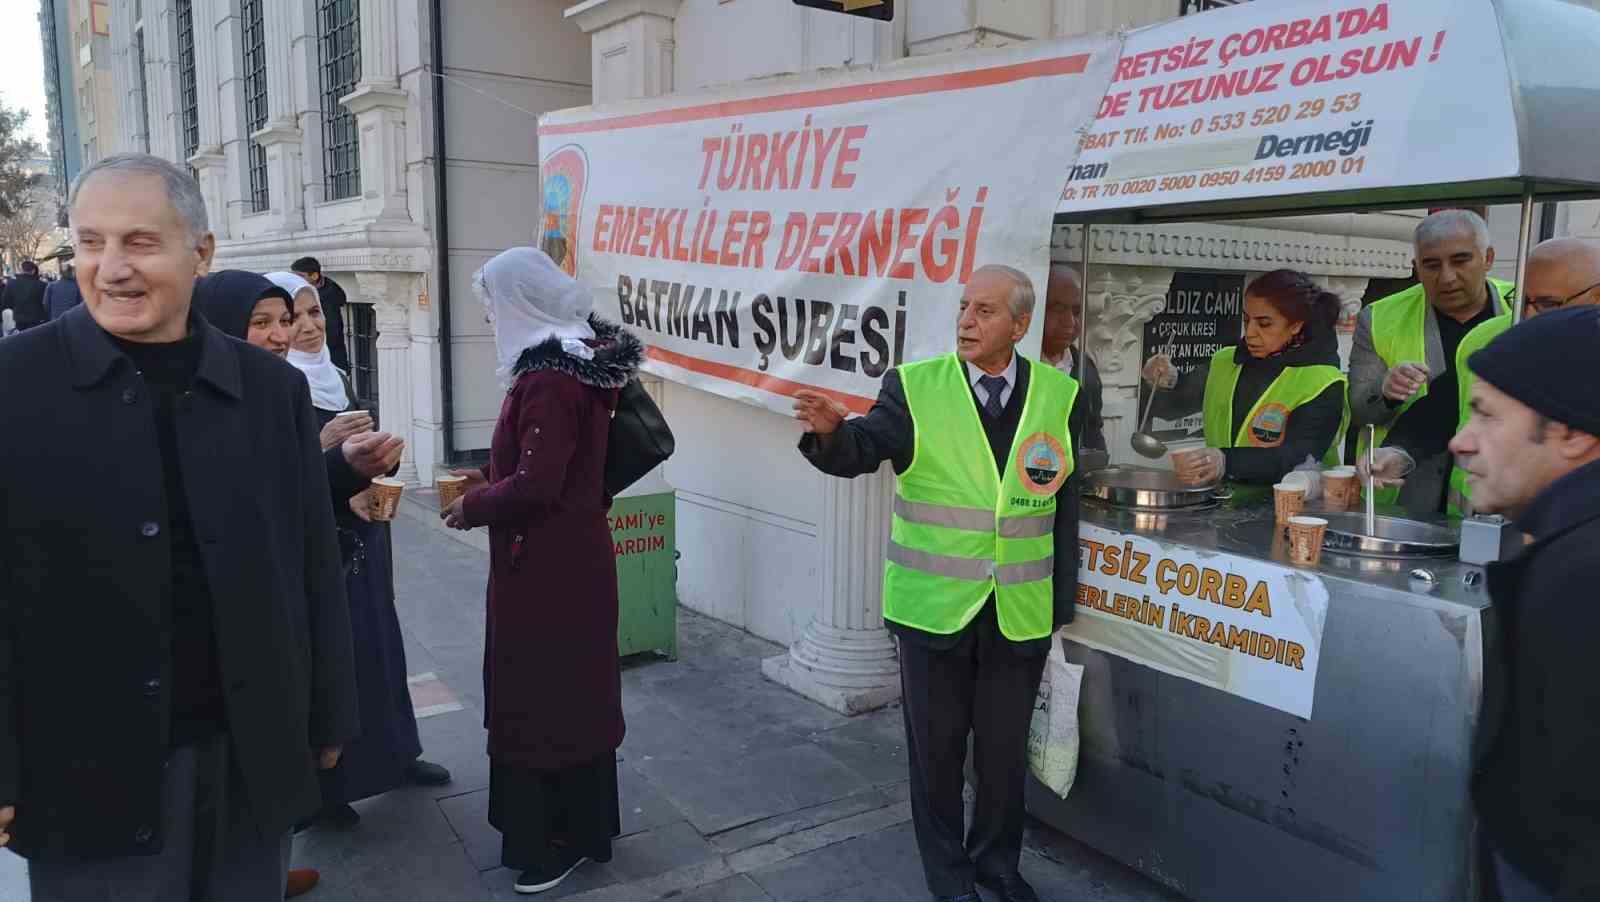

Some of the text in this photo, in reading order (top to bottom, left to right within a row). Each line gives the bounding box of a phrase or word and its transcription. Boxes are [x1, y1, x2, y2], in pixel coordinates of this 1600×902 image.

[1218, 3, 1389, 61] ÇORBA'DA
[1138, 64, 1280, 112] TUZUNUZ
[1290, 37, 1422, 88] OLSUN
[1429, 30, 1446, 63] !
[698, 114, 868, 191] TÜRKİYE
[1083, 130, 1120, 151] BAT
[1154, 122, 1185, 141] No:
[1190, 118, 1203, 136] 0
[1208, 112, 1246, 133] 533
[1250, 103, 1291, 127] 520
[1295, 98, 1325, 121] 29
[1329, 92, 1361, 114] 53
[1255, 119, 1374, 160] Derneği
[1082, 185, 1099, 199] TR
[1121, 179, 1156, 196] 0020
[1158, 174, 1197, 192] 5000
[1200, 170, 1240, 188] 0950
[1242, 164, 1287, 184] 4159
[1289, 159, 1337, 181] 2000
[1340, 155, 1366, 175] 01
[593, 186, 989, 285] EMEKLİLER DERNEĞİ
[617, 274, 908, 379] BATMAN ŞUBESİ
[1156, 558, 1272, 618] ÇORBA
[1169, 602, 1305, 671] İKRAMIDIR
